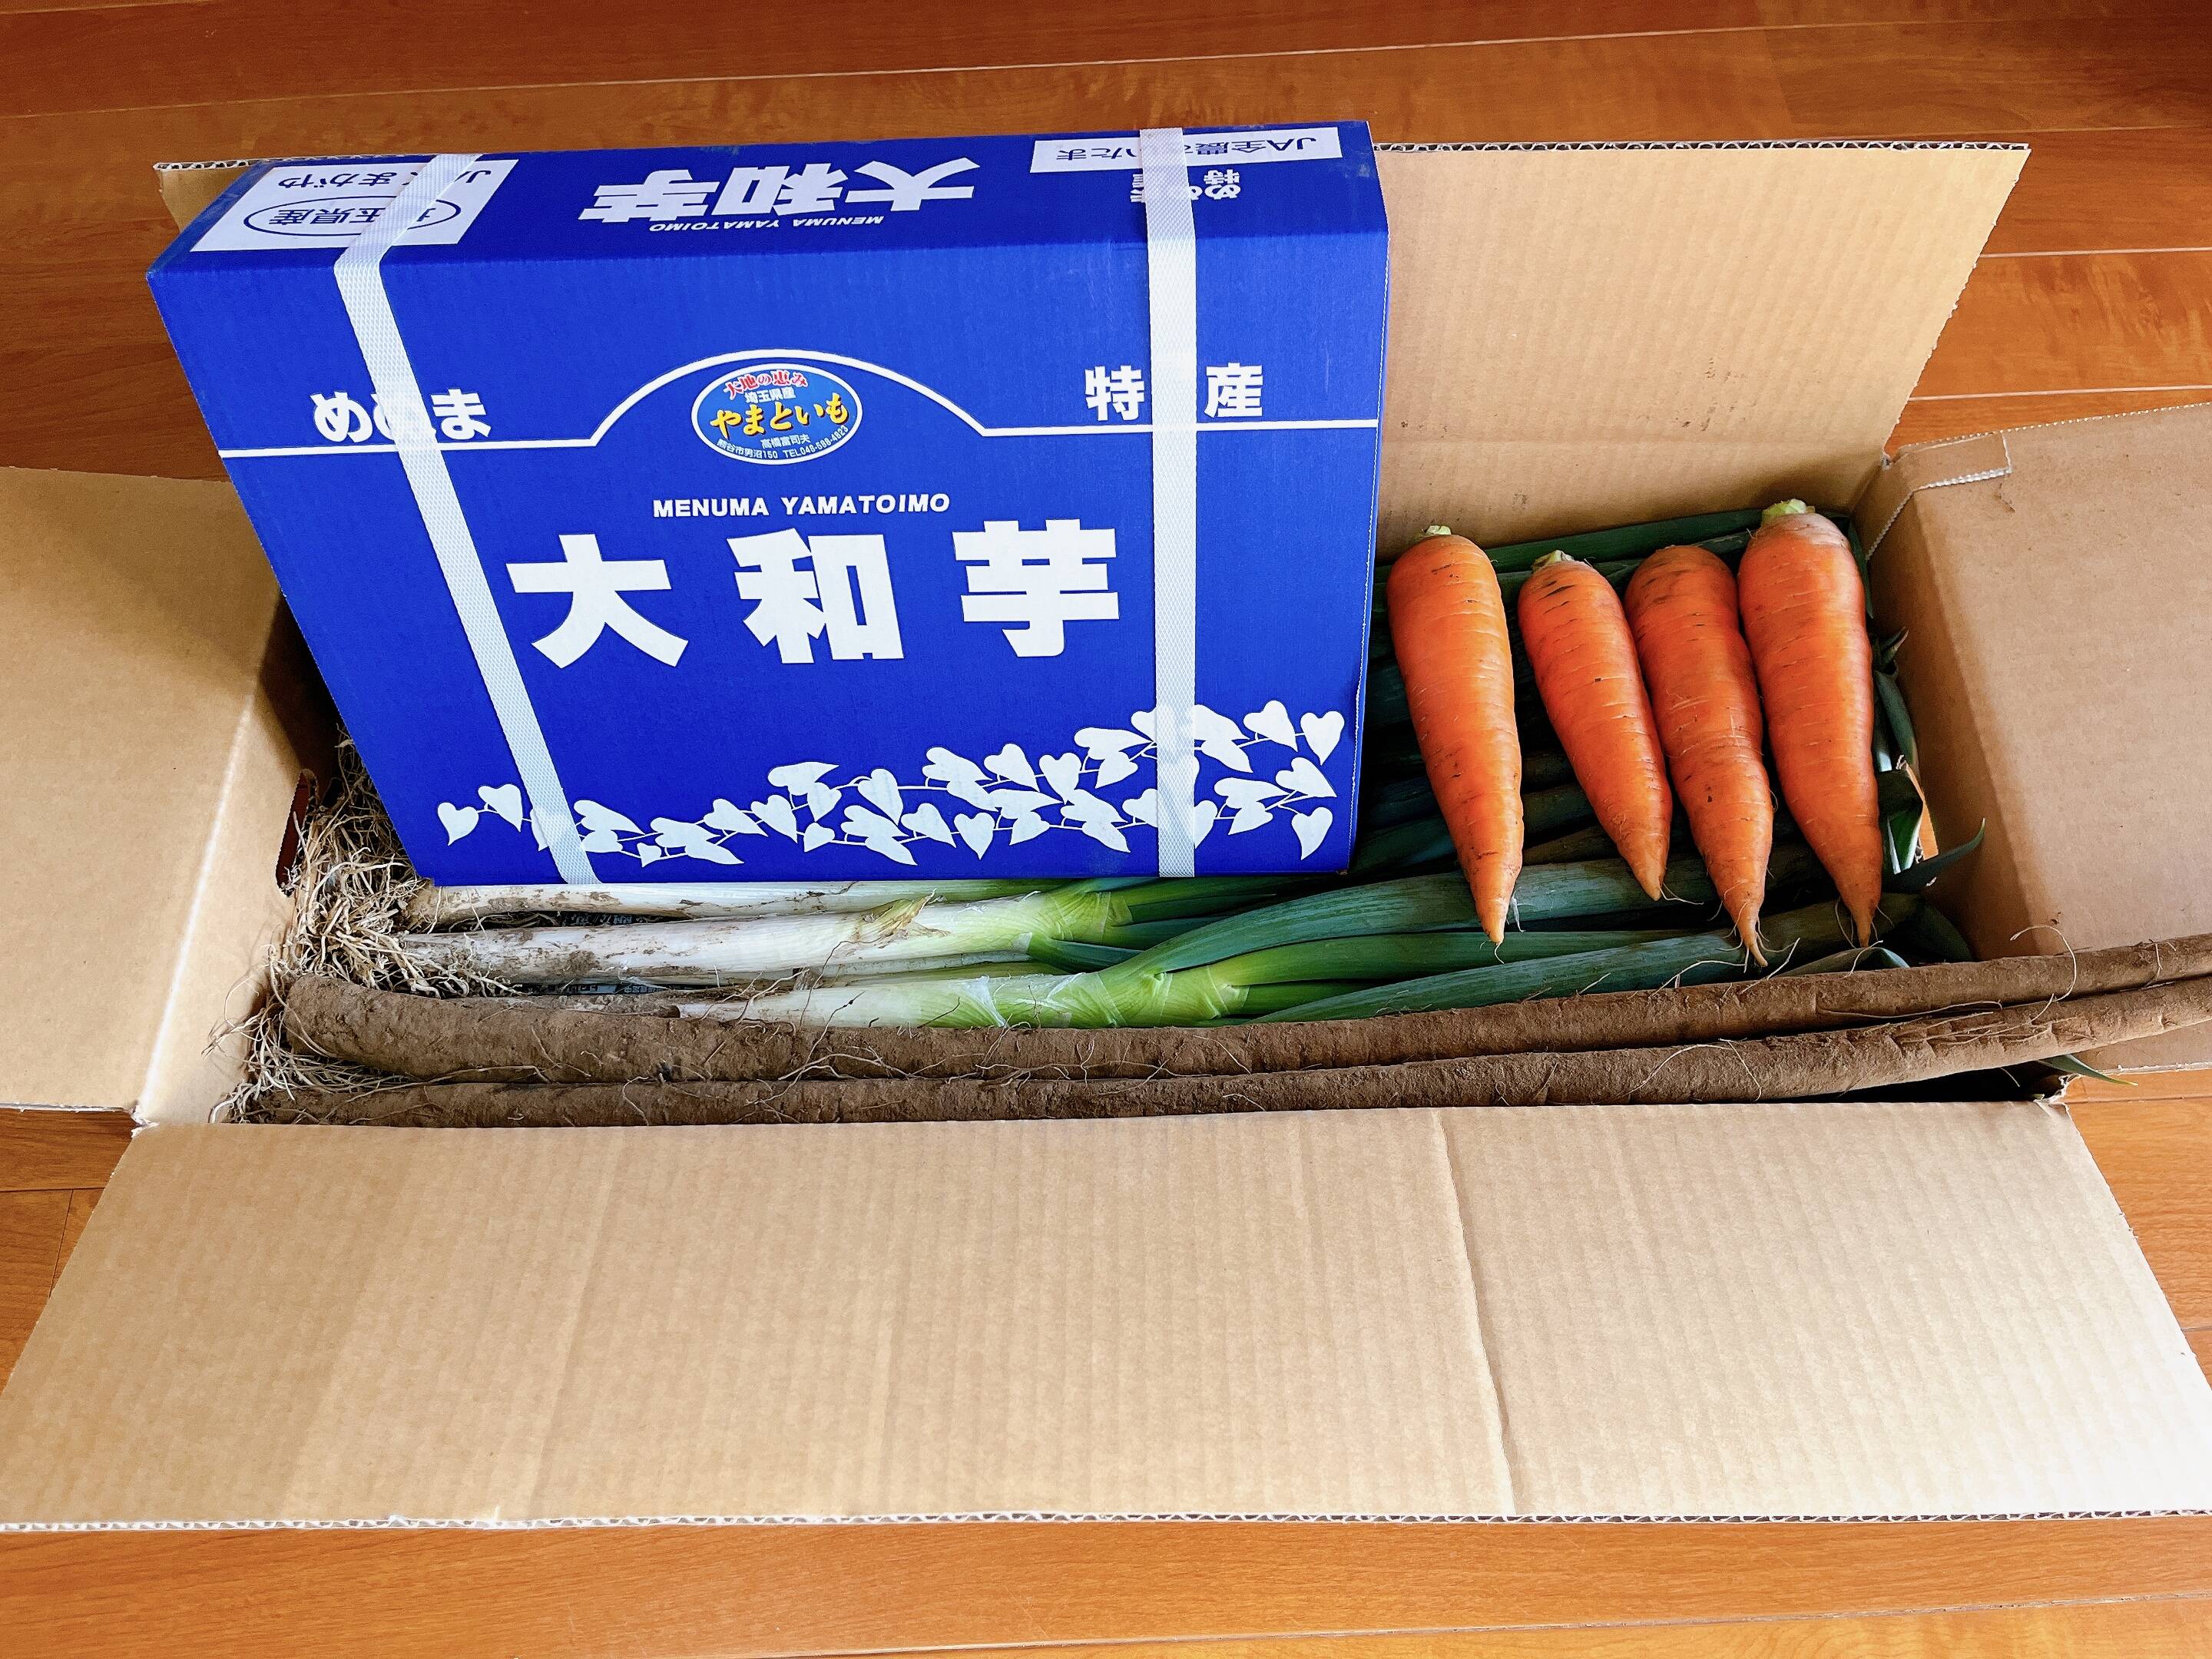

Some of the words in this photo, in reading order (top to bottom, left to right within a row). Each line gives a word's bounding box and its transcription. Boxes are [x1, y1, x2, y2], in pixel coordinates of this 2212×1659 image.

[278, 169, 492, 190] Jまがや
[578, 156, 981, 224] 大和芋
[650, 220, 780, 232] YAMATOIMO
[793, 216, 884, 227] MENUMA
[724, 369, 809, 400] 大地の恵み
[744, 386, 796, 404] 埼玉県産
[1084, 362, 1263, 422] 特産
[710, 392, 850, 441] やまといも
[653, 497, 770, 518] MENUMA
[780, 493, 950, 515] YAMATOIMO
[506, 518, 1120, 669] 大和芋
